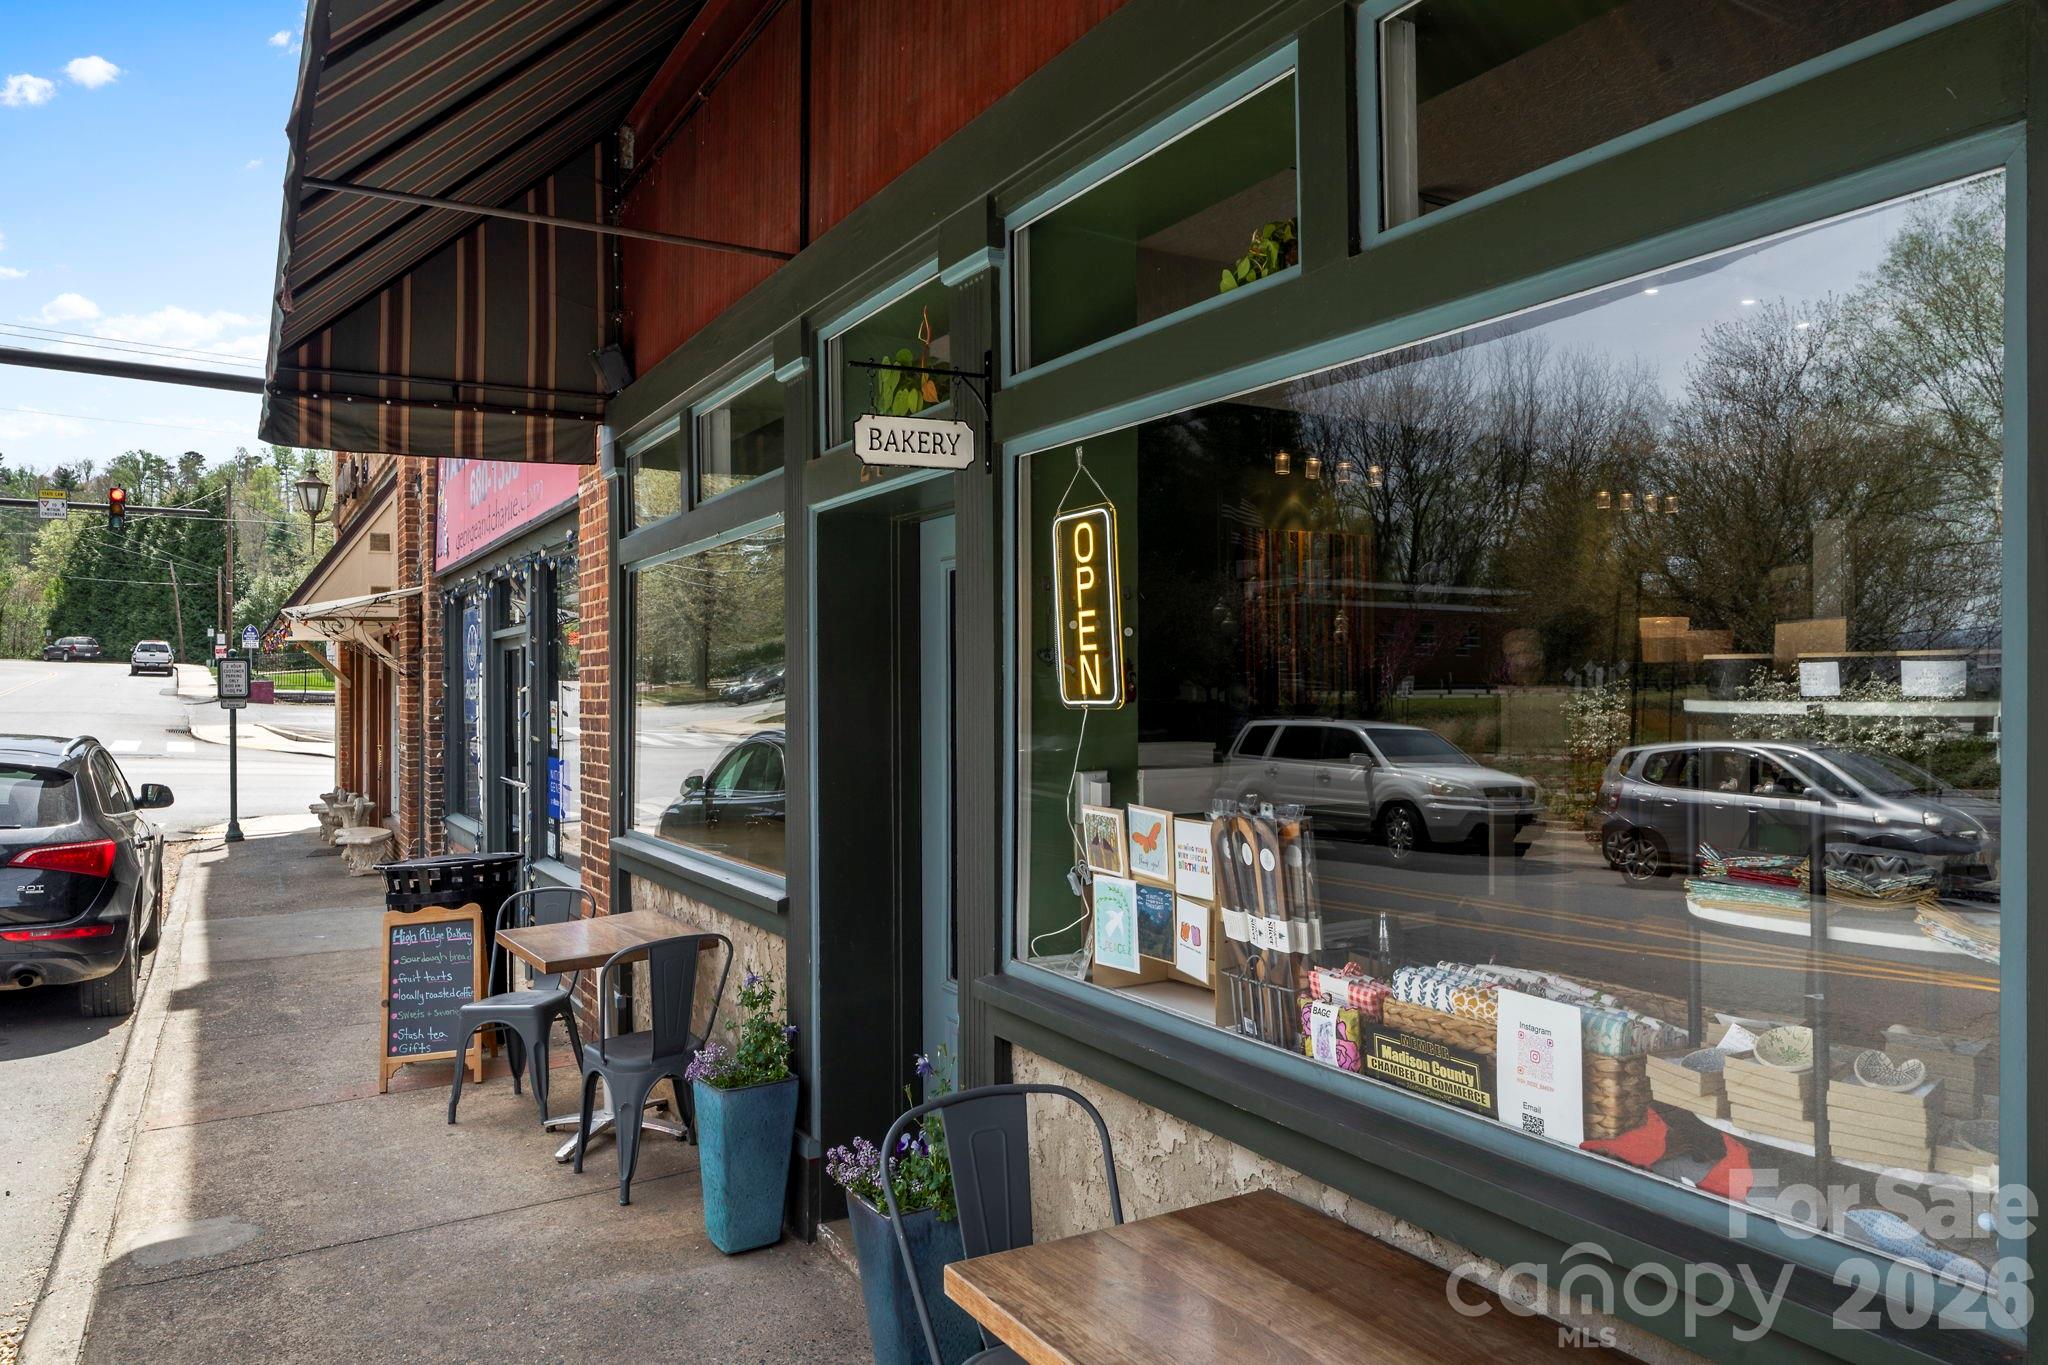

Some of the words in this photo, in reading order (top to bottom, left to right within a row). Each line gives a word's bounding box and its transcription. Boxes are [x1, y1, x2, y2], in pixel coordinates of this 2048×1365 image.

[868, 427, 961, 456] BAKERY
[1073, 521, 1101, 695] OPEN
[391, 928, 417, 946] High
[419, 927, 445, 948] Ridge
[446, 926, 473, 945] Bakery
[449, 948, 473, 962] bread
[398, 969, 421, 983] fruit
[423, 970, 453, 982] tarts
[398, 988, 424, 1006] locally
[425, 987, 455, 999] roasted
[427, 1026, 448, 1040] tea
[1519, 1021, 1552, 1037] Instagram
[399, 1042, 431, 1053] Gifts
[1400, 1033, 1450, 1060] MEMBER
[1381, 1044, 1431, 1073] Madison
[1431, 1060, 1474, 1087] County
[1371, 1058, 1417, 1081] CHAMBER
[1418, 1070, 1430, 1085] OF
[1431, 1077, 1487, 1105] COMMERCE
[1522, 1101, 1542, 1114] Email
